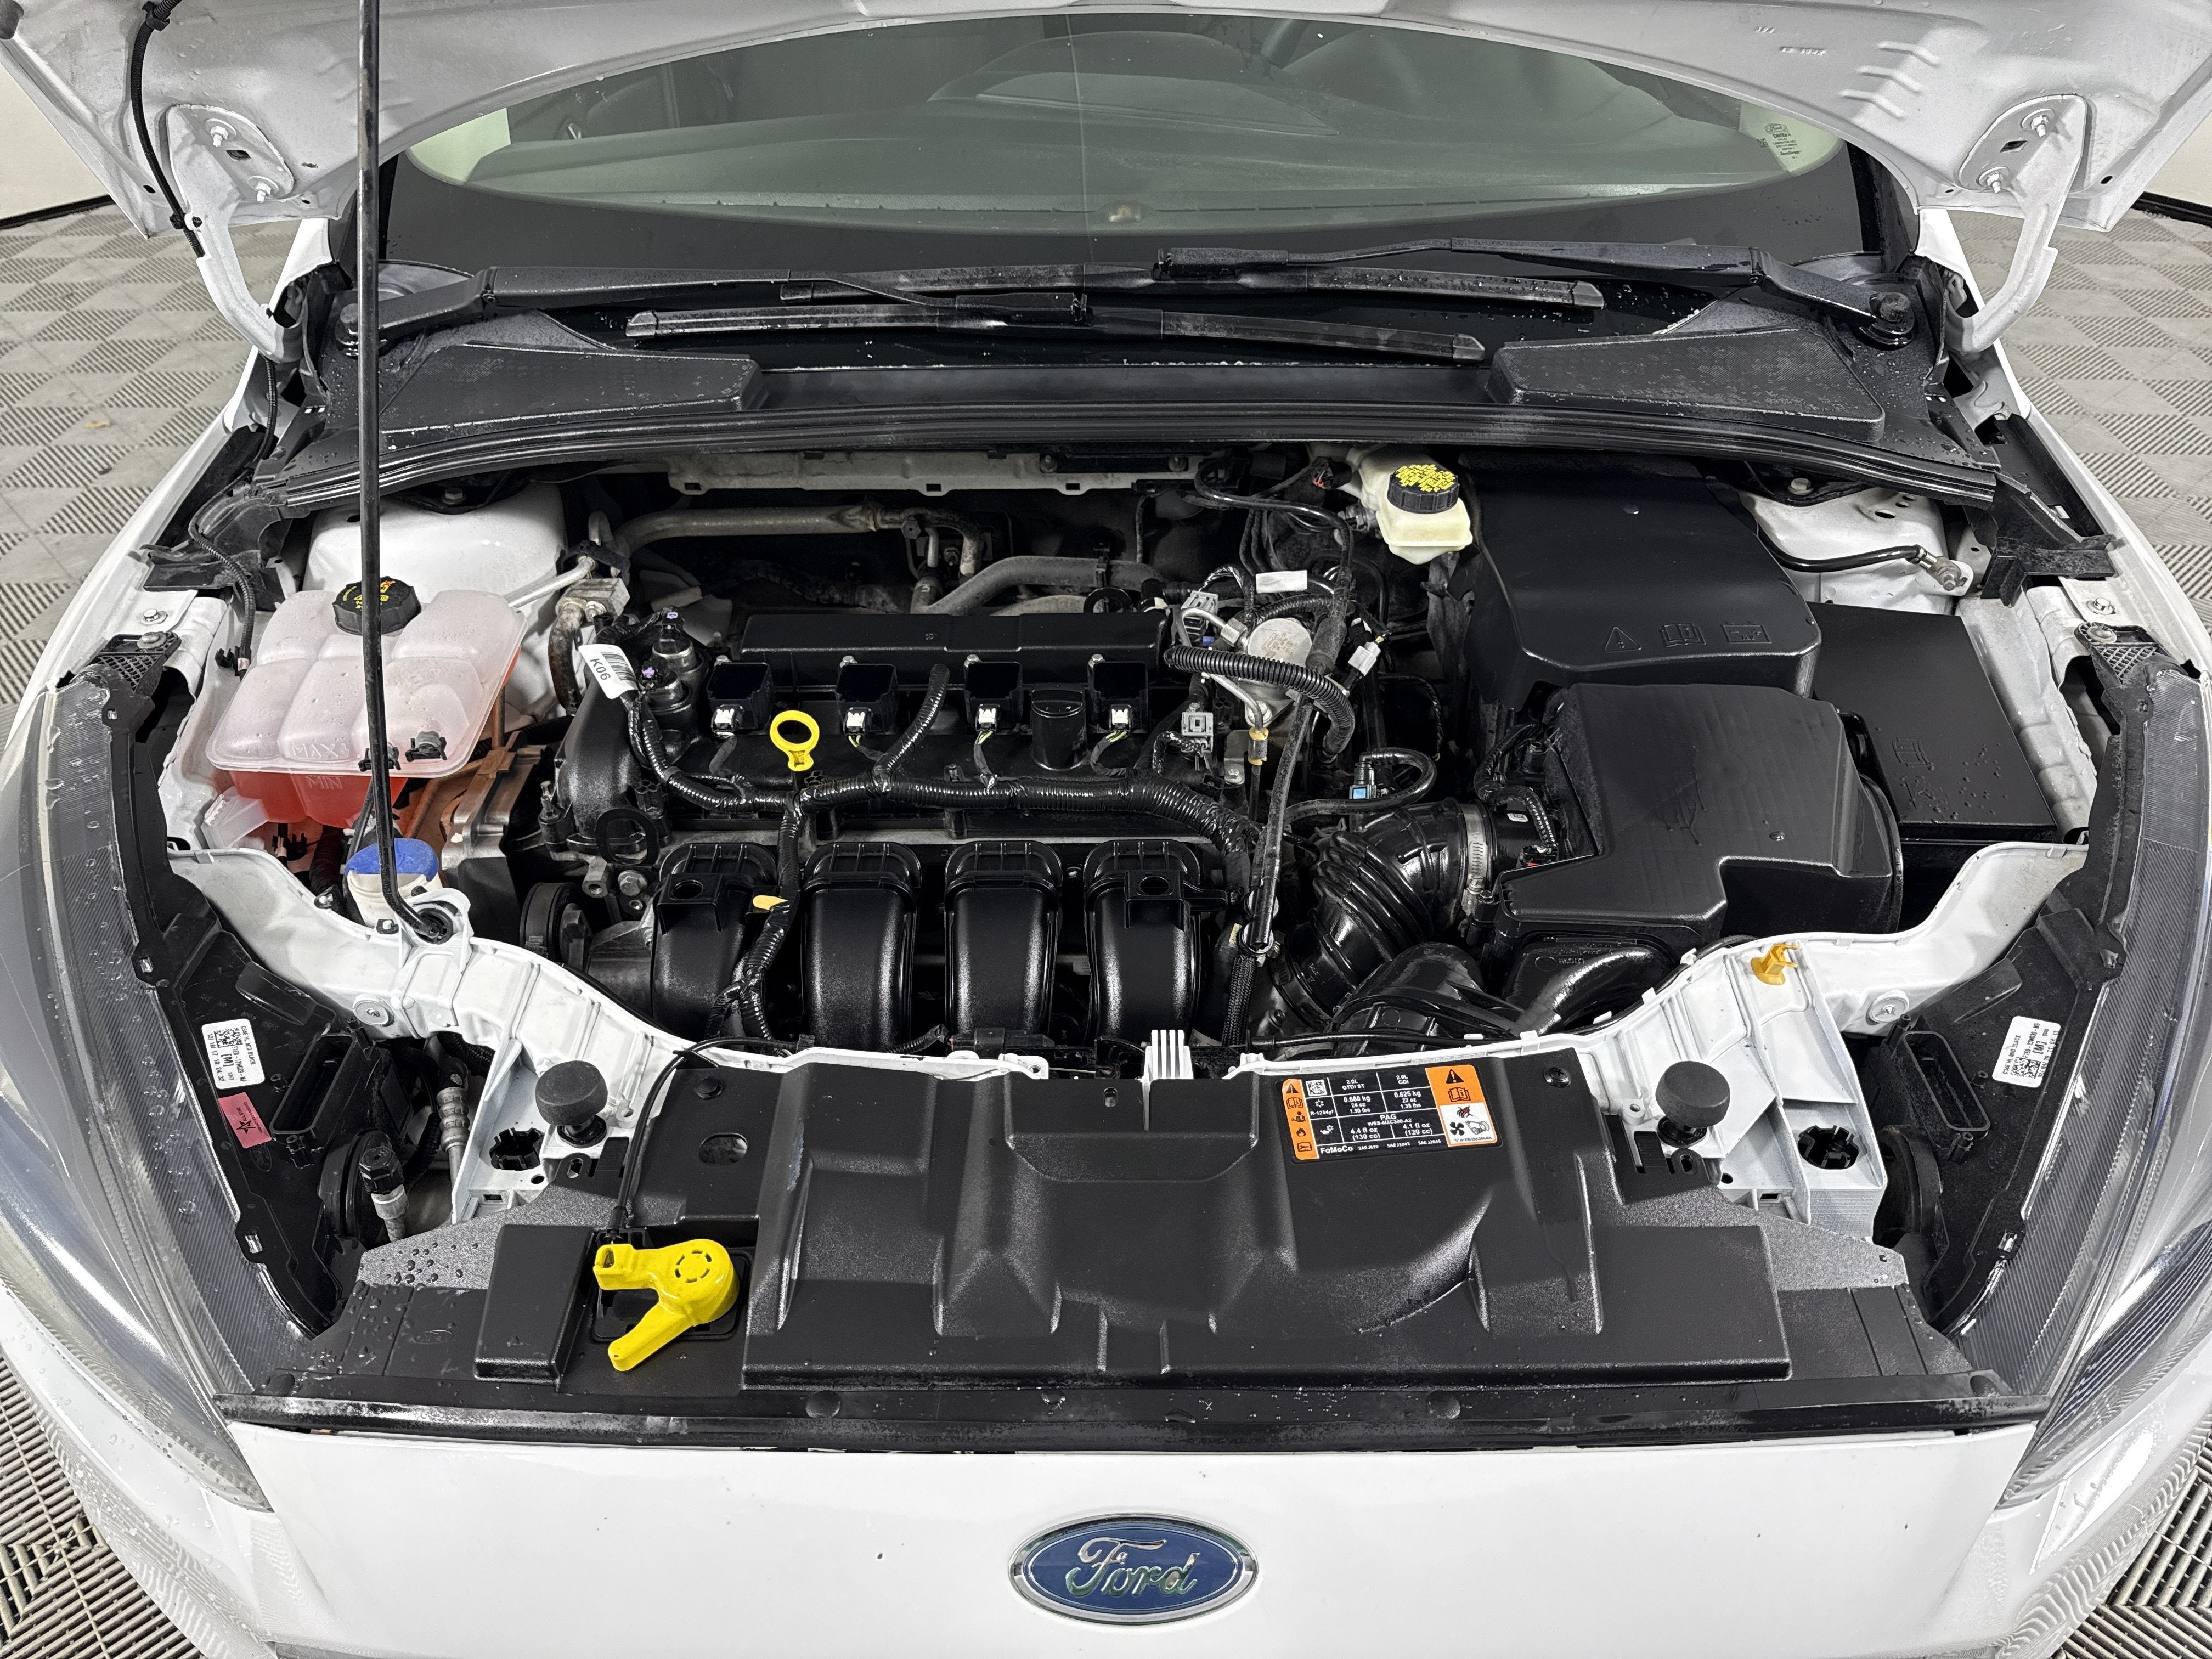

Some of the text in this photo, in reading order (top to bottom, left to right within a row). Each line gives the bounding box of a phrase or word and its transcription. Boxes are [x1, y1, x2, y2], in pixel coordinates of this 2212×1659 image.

[590, 658, 611, 681] K06
[292, 743, 338, 757] MAX
[305, 775, 343, 789] MIN
[247, 1052, 256, 1065] BLACK
[1352, 1133, 1368, 1142] (130
[1405, 1128, 1420, 1137] (120
[1320, 1145, 1353, 1154] FoMoCo
[1065, 1537, 1201, 1598] Ford
